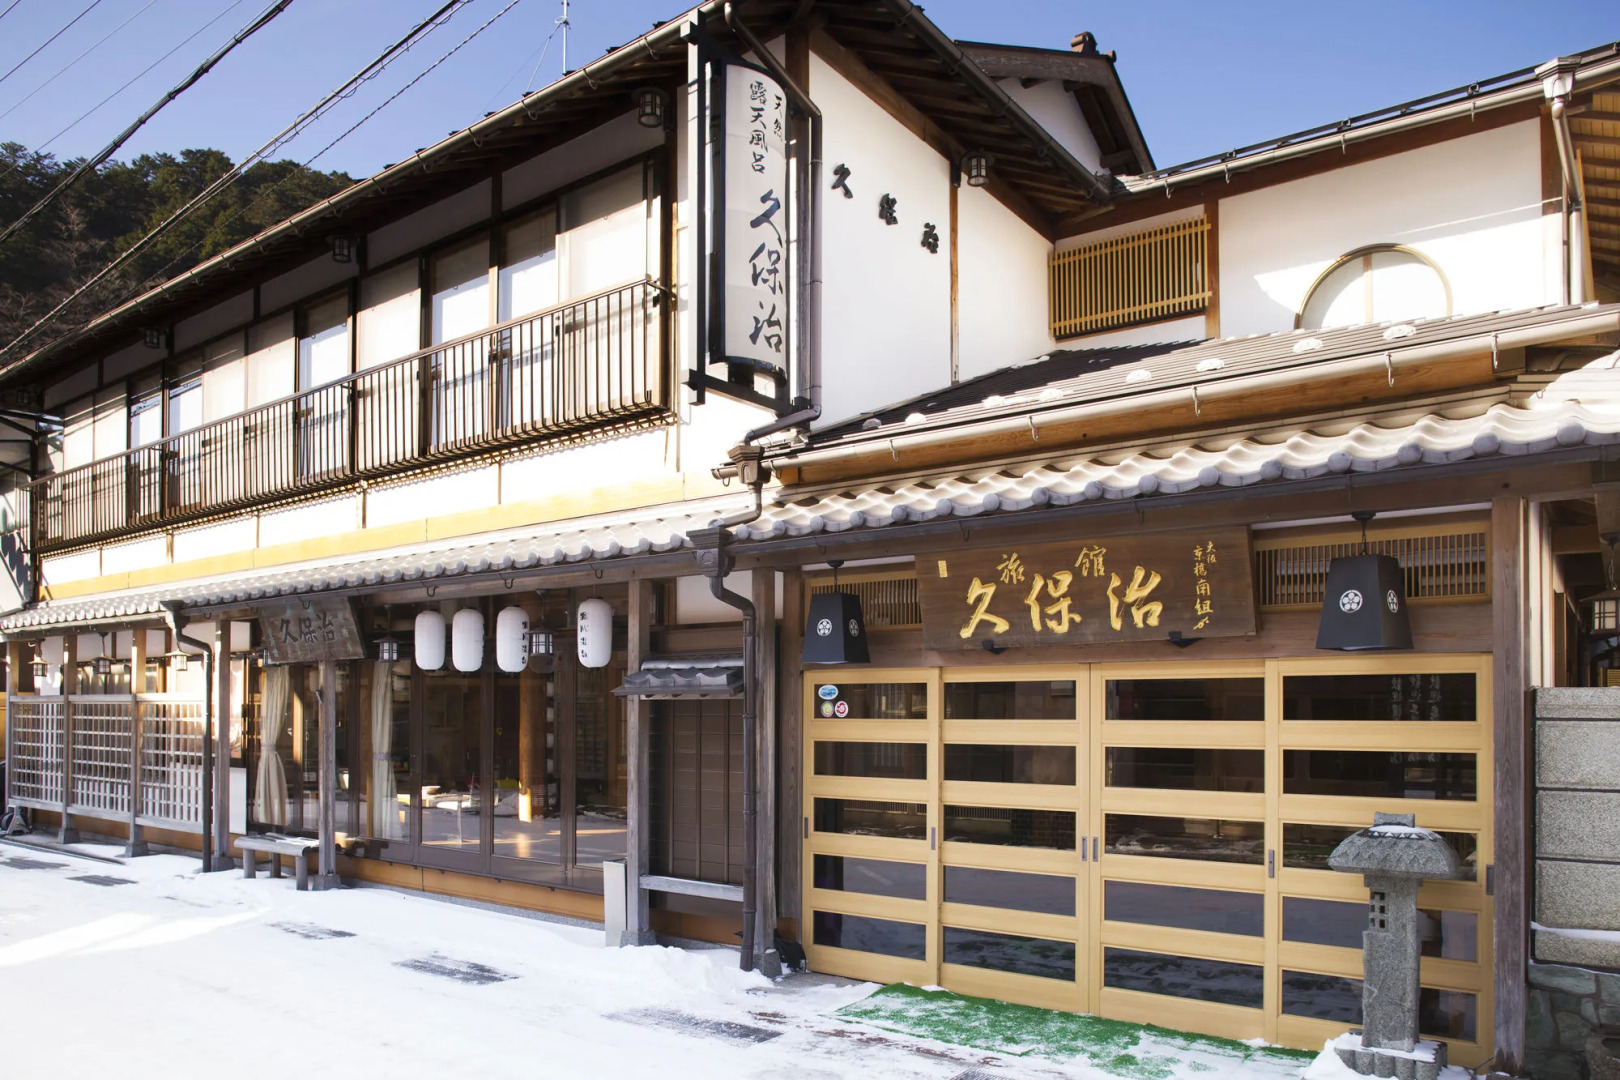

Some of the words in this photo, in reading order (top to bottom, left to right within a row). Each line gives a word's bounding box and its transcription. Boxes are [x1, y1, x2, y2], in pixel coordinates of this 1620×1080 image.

[749, 80, 769, 174] 露天風呂
[749, 189, 783, 353] 久保治
[997, 544, 1108, 585] 旅館
[279, 609, 337, 644] 久保治
[960, 566, 1164, 640] 久保治
